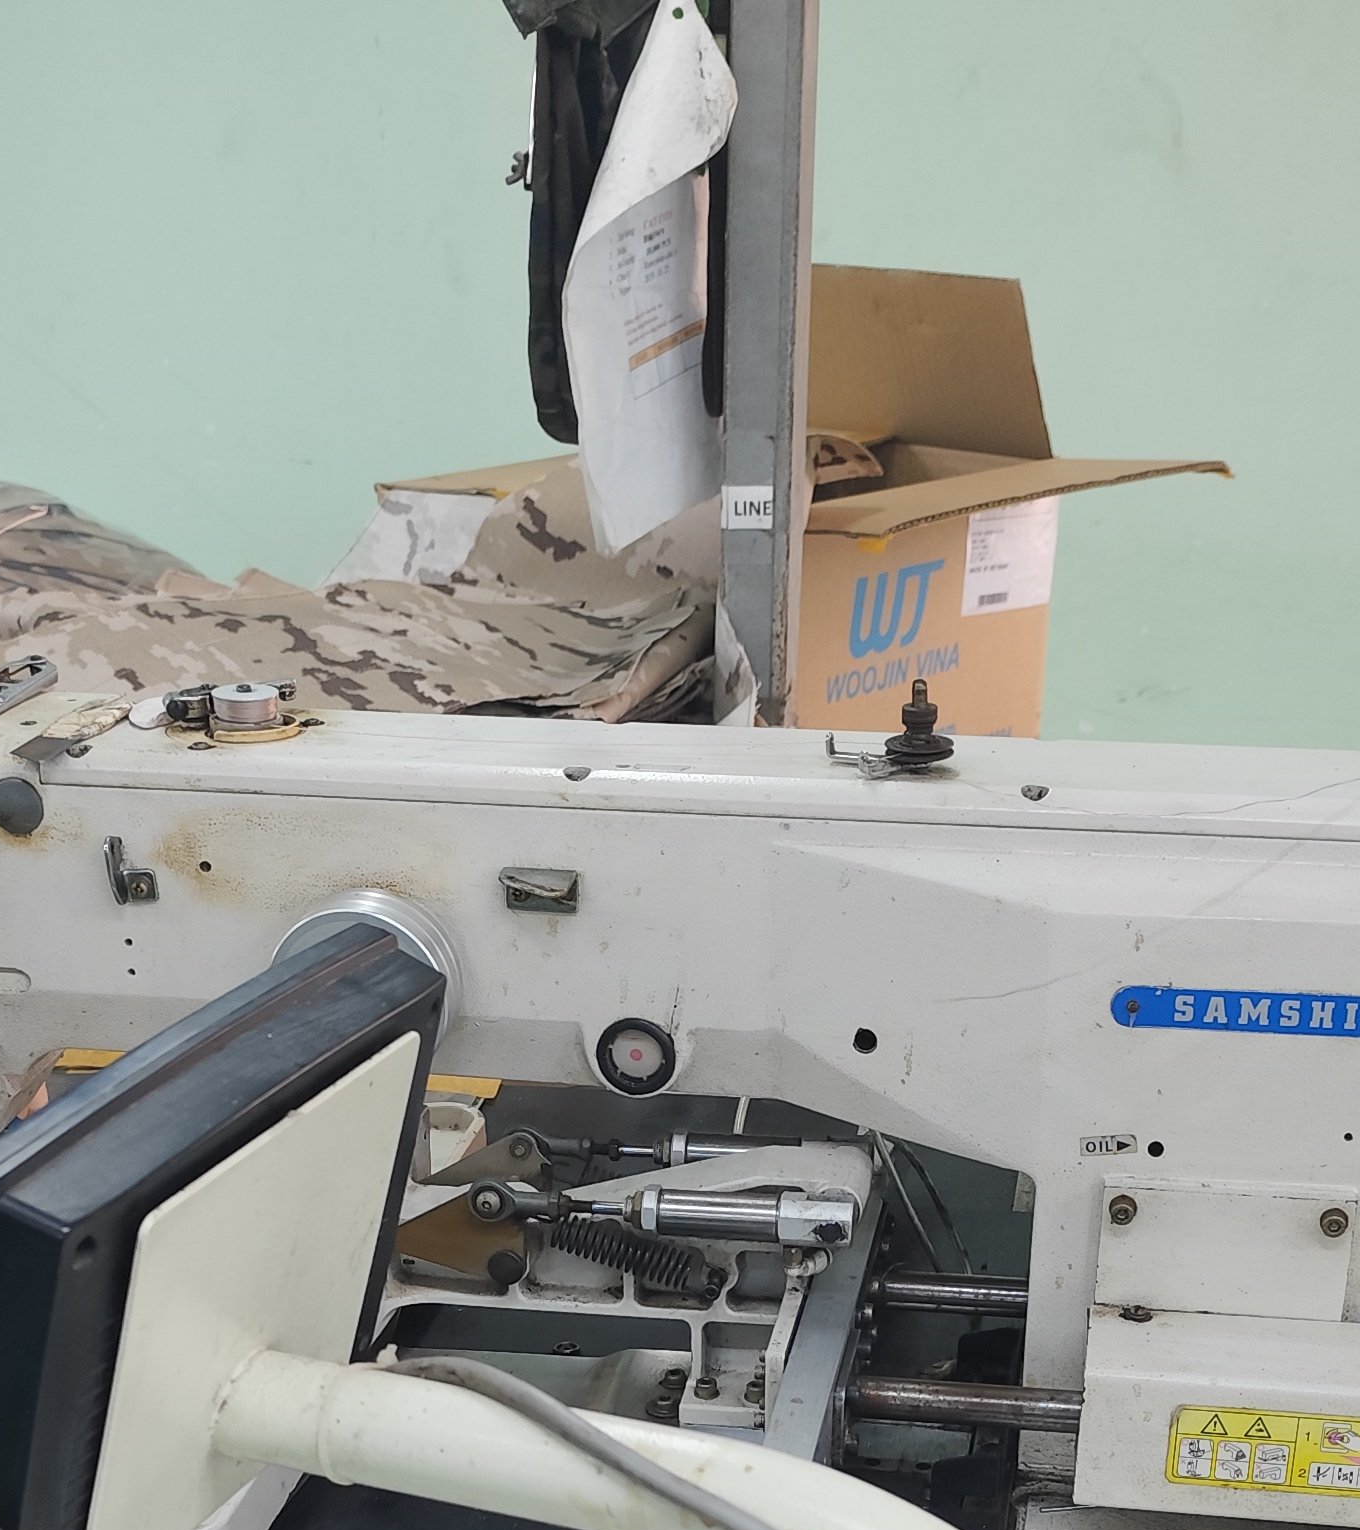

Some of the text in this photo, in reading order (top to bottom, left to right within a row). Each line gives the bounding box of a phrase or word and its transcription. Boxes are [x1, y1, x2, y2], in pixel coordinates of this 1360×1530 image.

[734, 500, 773, 517] LINE
[826, 642, 960, 704] WOOJIN VINA
[1084, 1139, 1114, 1155] OIL
[1297, 1468, 1307, 1479] 2
